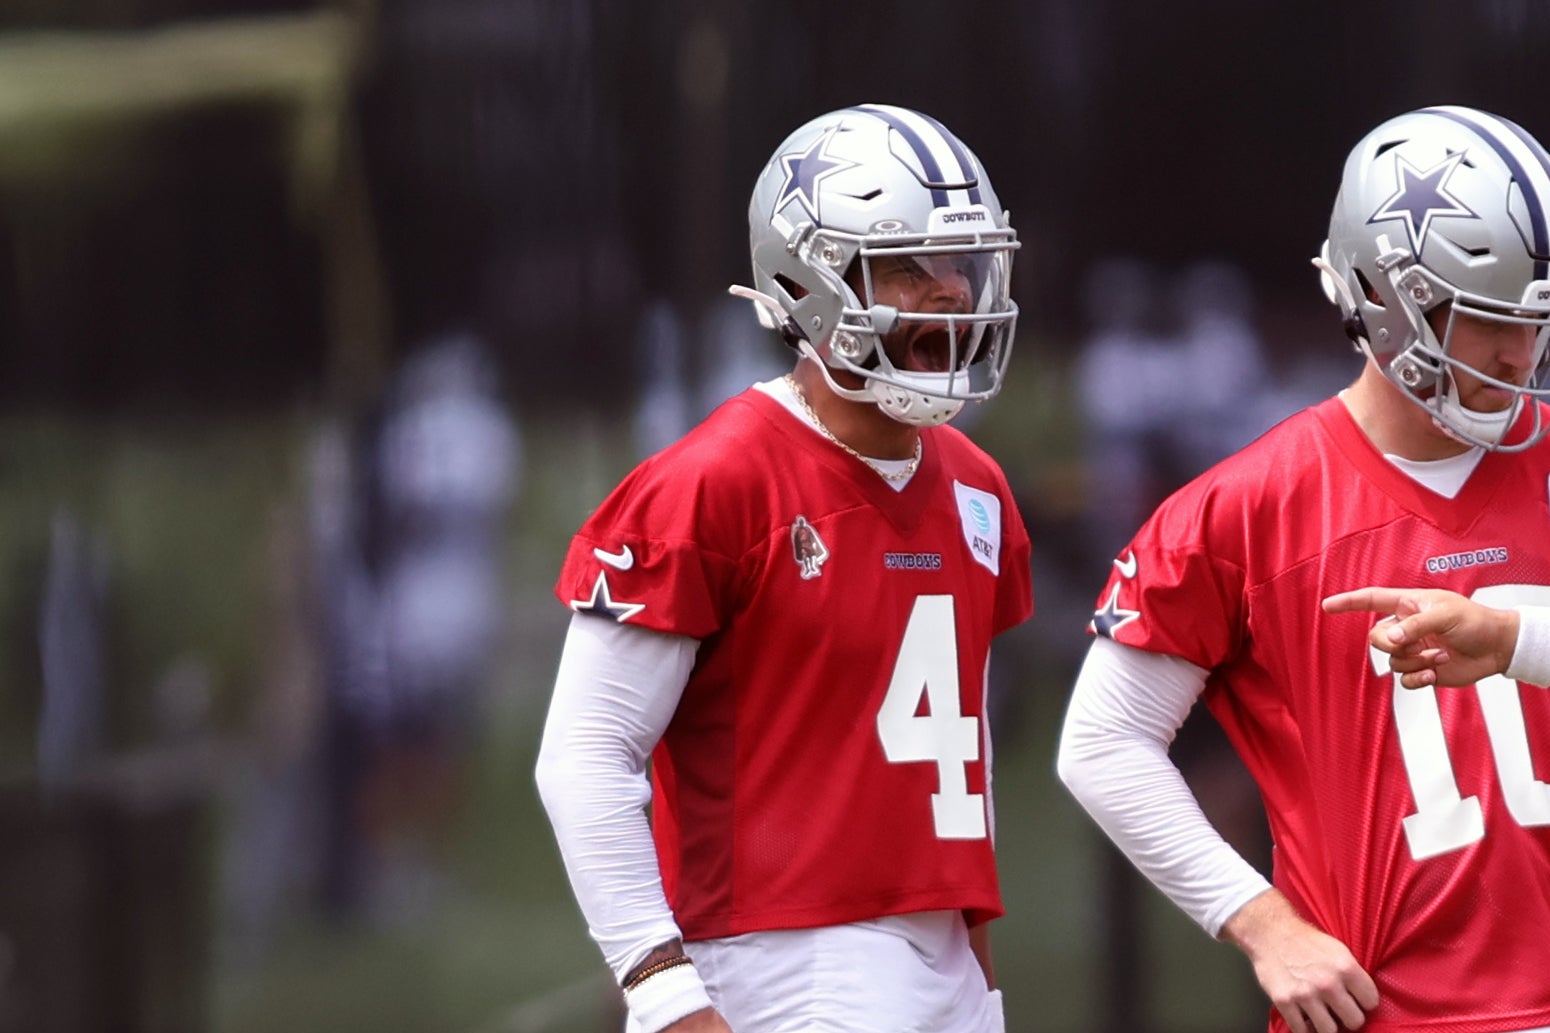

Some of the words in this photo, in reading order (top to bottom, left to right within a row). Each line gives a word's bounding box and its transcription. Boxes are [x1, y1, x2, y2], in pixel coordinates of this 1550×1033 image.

[973, 535, 993, 560] AT&T
[1427, 547, 1508, 573] COWBOYS
[884, 553, 942, 571] COWBOYS
[876, 594, 987, 839] 4
